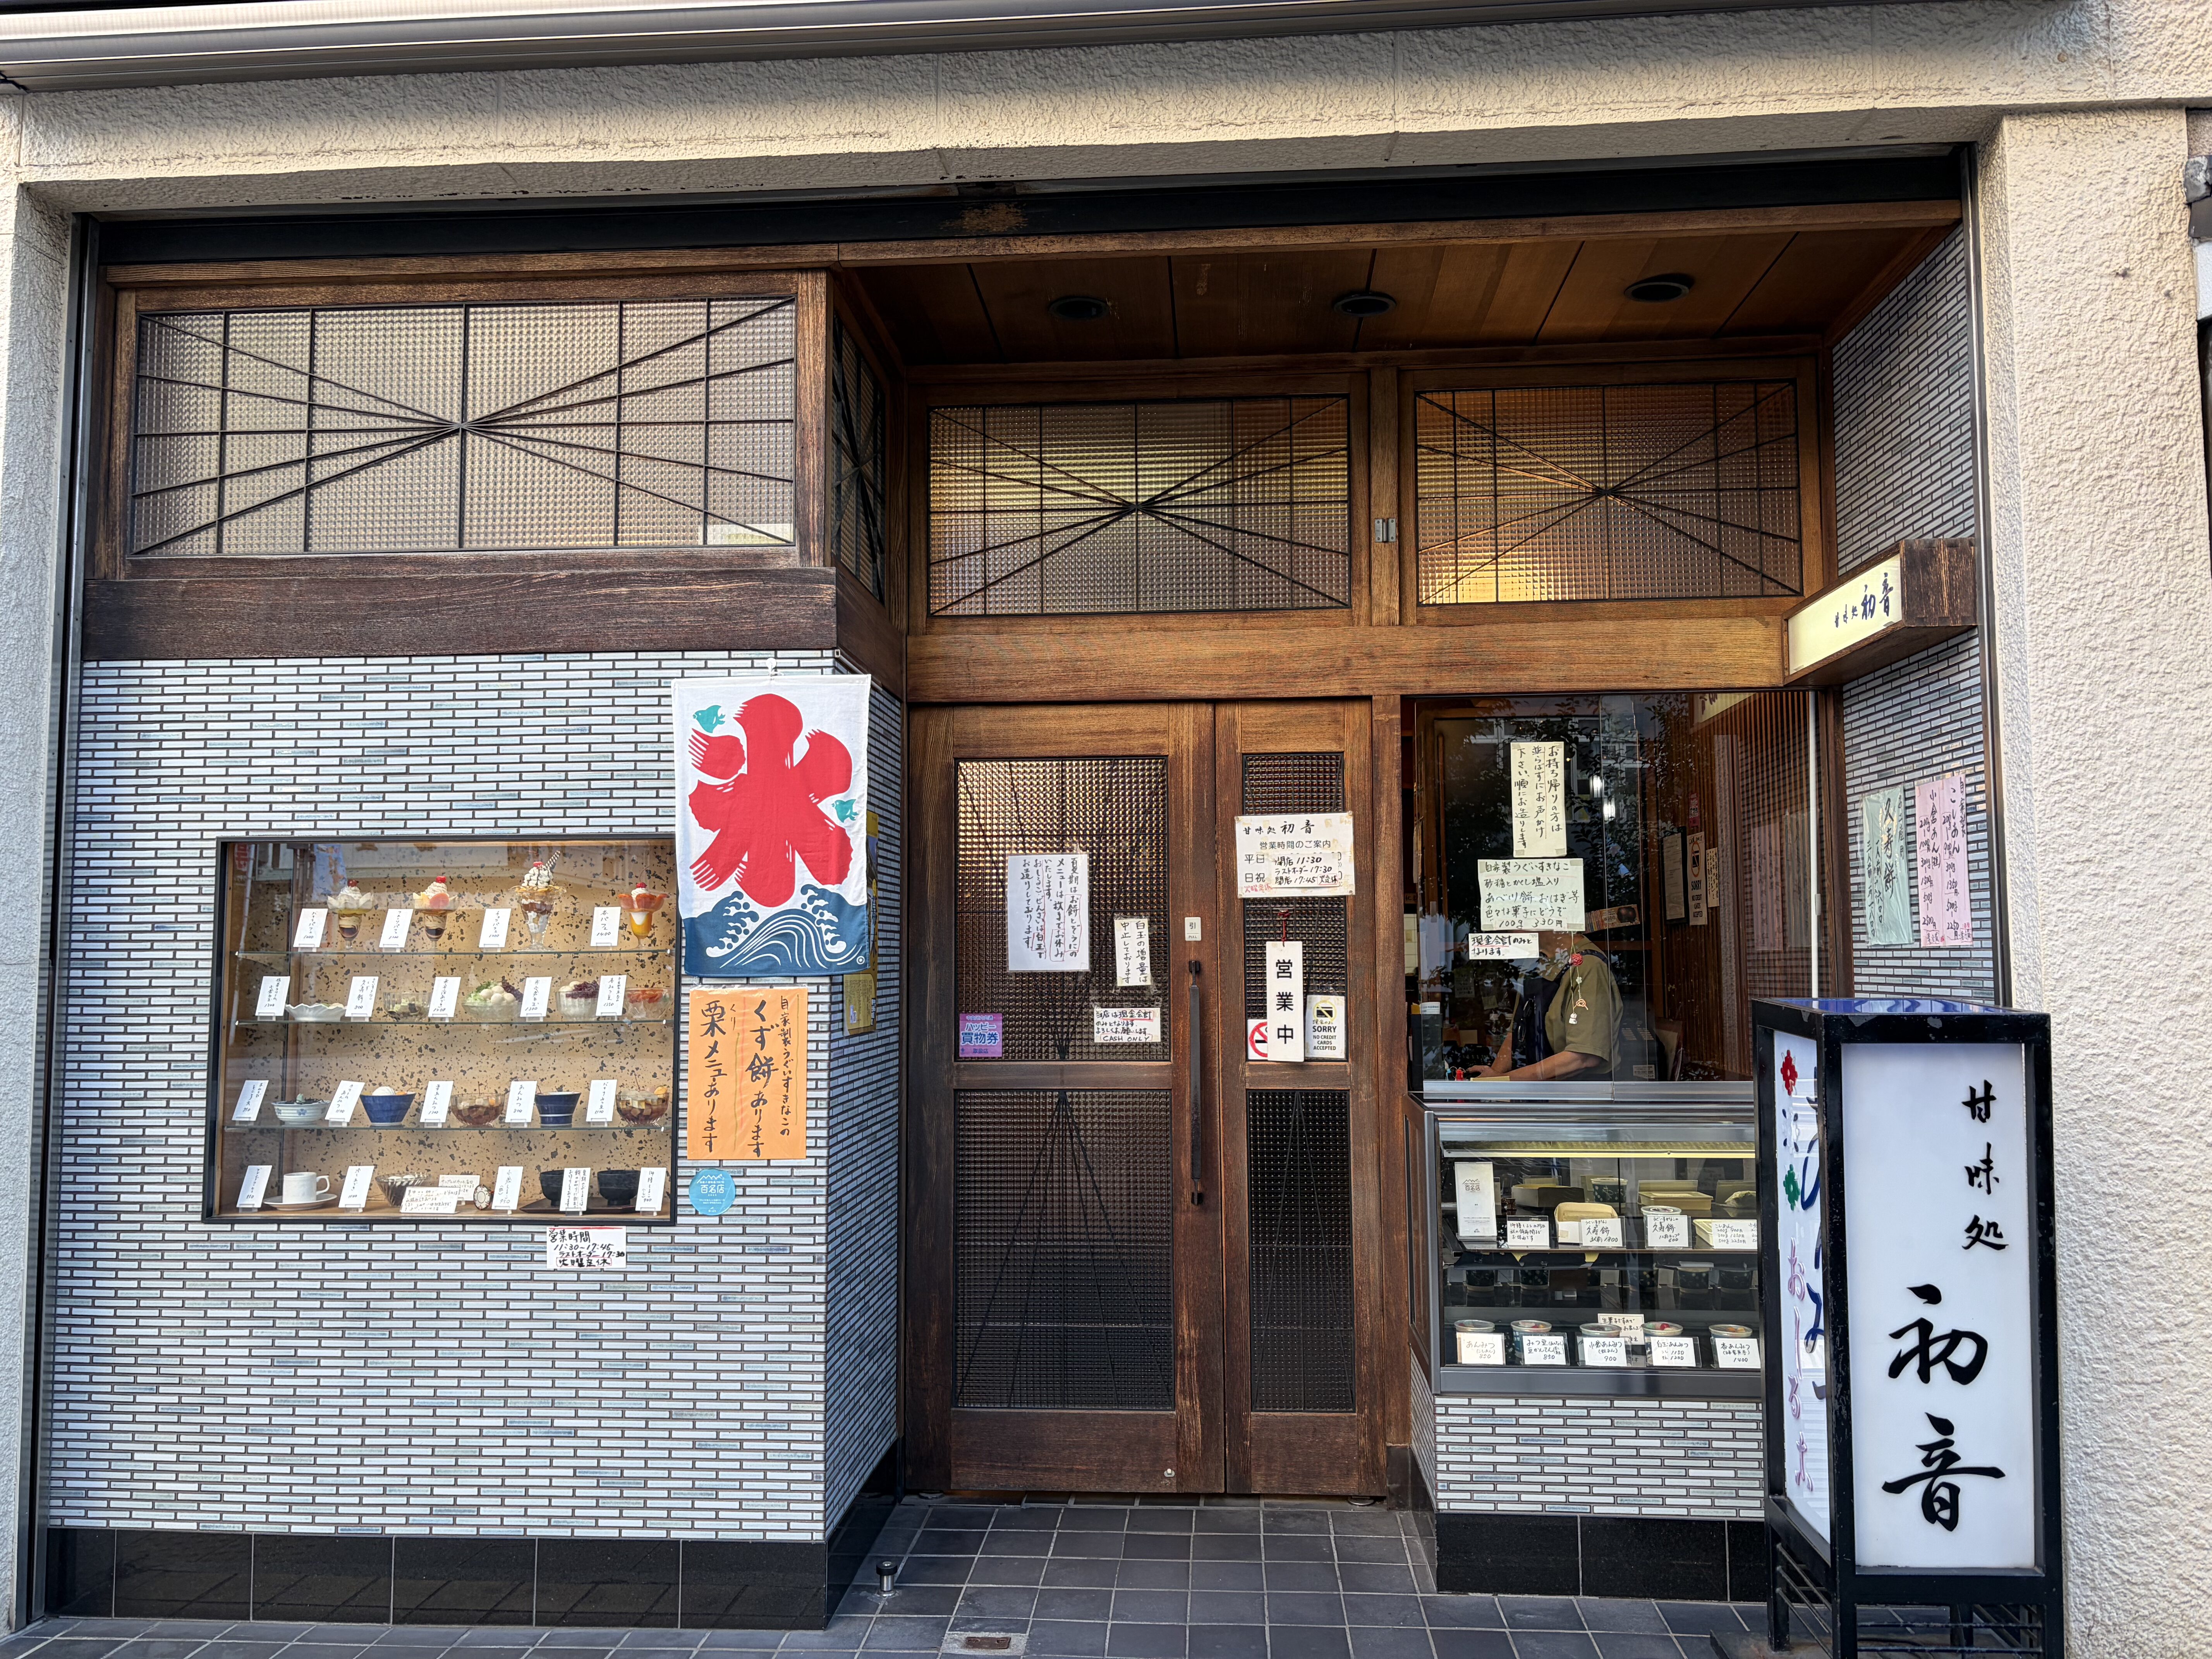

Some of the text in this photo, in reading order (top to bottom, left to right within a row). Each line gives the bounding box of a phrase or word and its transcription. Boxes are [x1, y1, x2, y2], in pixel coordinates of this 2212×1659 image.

[1532, 745, 1545, 838] 並らばずにお声かけ
[1546, 745, 1563, 831] お持ち帰りの方は
[1951, 788, 1960, 854] こしあん
[1260, 840, 1331, 850] 営業時間のご案内
[1244, 854, 1265, 864] 平日
[1275, 866, 1308, 875] ラストオーダー
[1245, 873, 1265, 883] 日祝
[1294, 876, 1317, 884] 17:45
[1484, 876, 1559, 889] 砂糖とかくし塩入り
[1053, 859, 1065, 957] メニューは秋までお休み
[1066, 858, 1079, 957] 夏期はお餅とぞうにの
[1485, 905, 1566, 919] 色々な菓子にどうぞ
[1499, 918, 1563, 929] 100g 330円
[1472, 934, 1532, 945] 現金会計のみと
[1120, 922, 1131, 984] 中止しております
[1135, 921, 1148, 983] 白玉の増量は
[1276, 959, 1294, 1044] 営業中
[965, 1022, 996, 1031] ハッピー
[1096, 1027, 1147, 1036] よろしくお願いします
[961, 1032, 999, 1044] 買物券
[779, 995, 794, 1136] 自家製うぐいすきなこの
[700, 1000, 728, 1153] 栗メニューあります
[745, 999, 779, 1158] くず餅あります
[1962, 1080, 2009, 1251] 甘味処
[701, 1184, 725, 1193] 百名店
[549, 1229, 591, 1243] 営業時間
[1882, 1284, 2005, 1532] 初音
